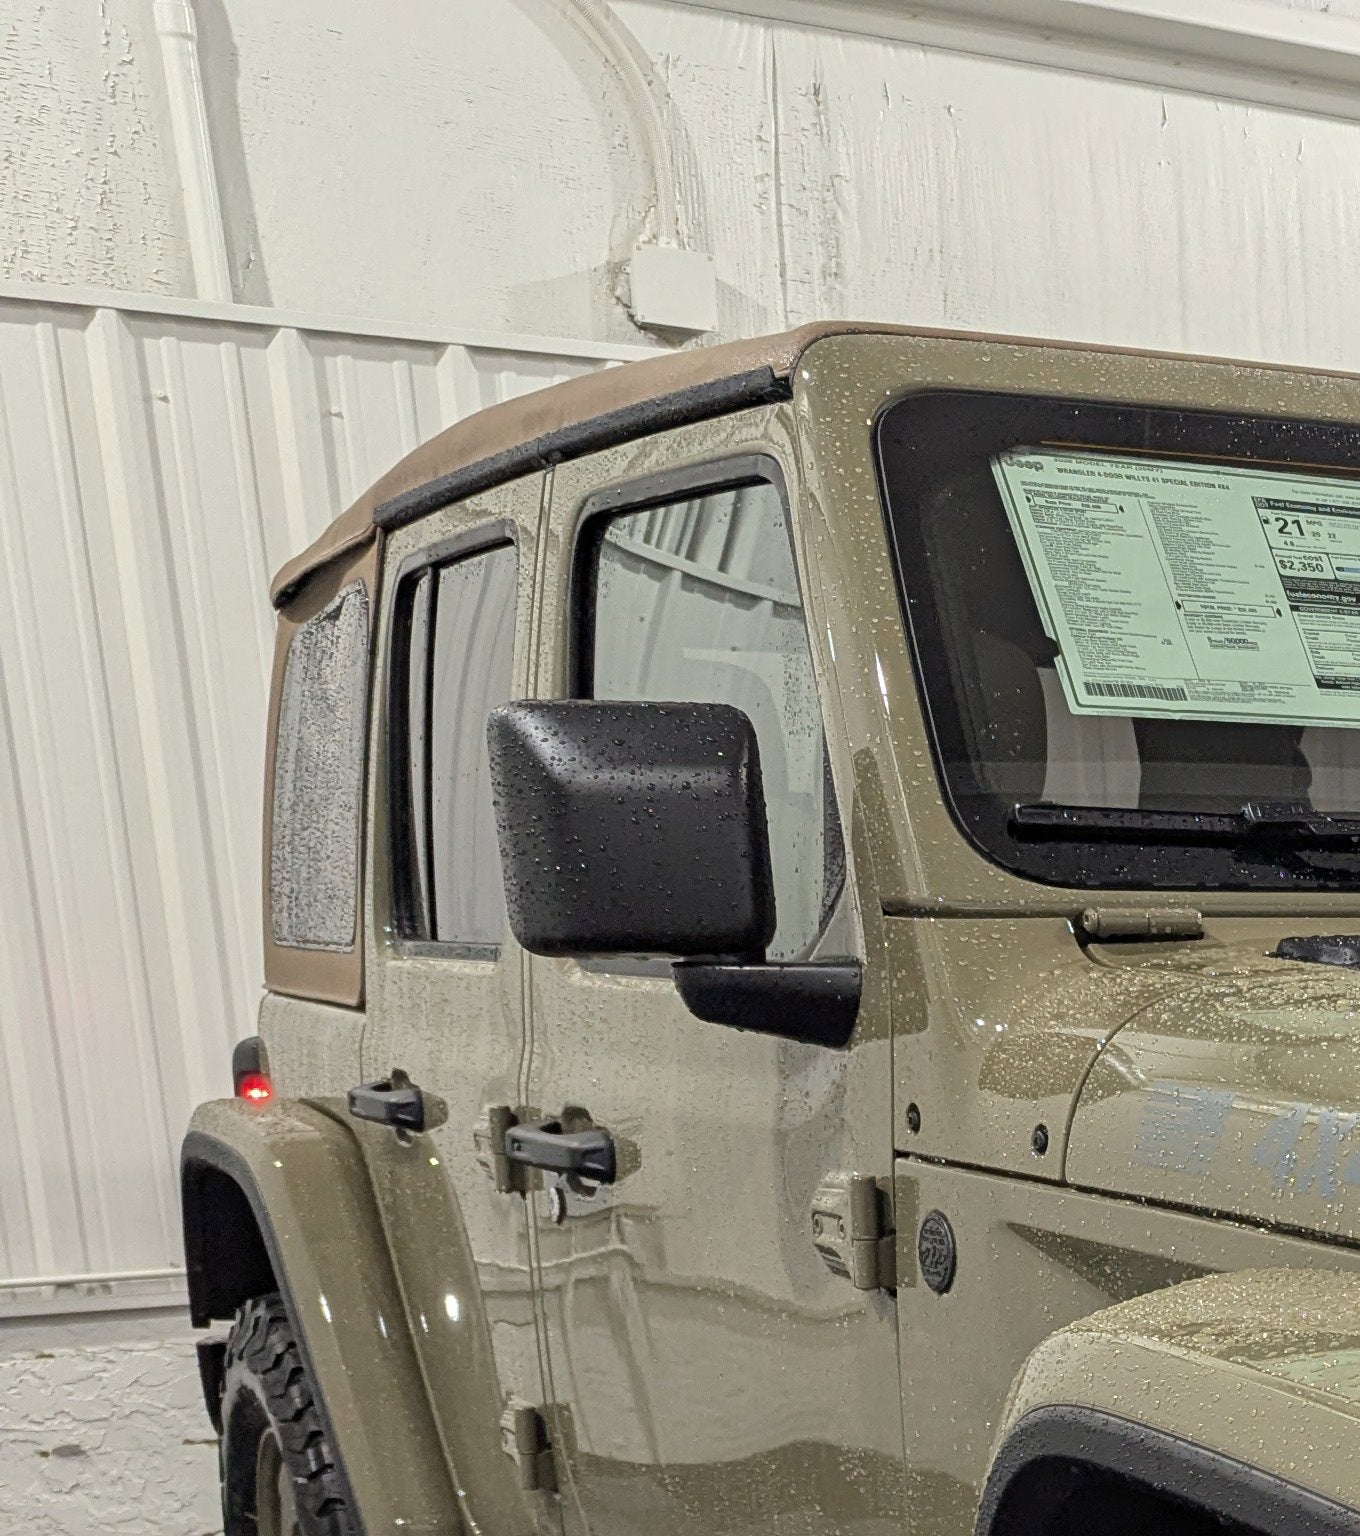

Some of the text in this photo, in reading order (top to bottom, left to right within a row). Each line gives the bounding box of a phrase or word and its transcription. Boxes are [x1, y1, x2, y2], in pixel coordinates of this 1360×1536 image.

[1057, 467, 1096, 478] WRANGLER
[1189, 480, 1216, 489] EDITION
[1286, 502, 1316, 513] Economy
[1274, 517, 1305, 536] 21
[1306, 519, 1323, 527] MPG
[1278, 559, 1324, 573] $2,350
